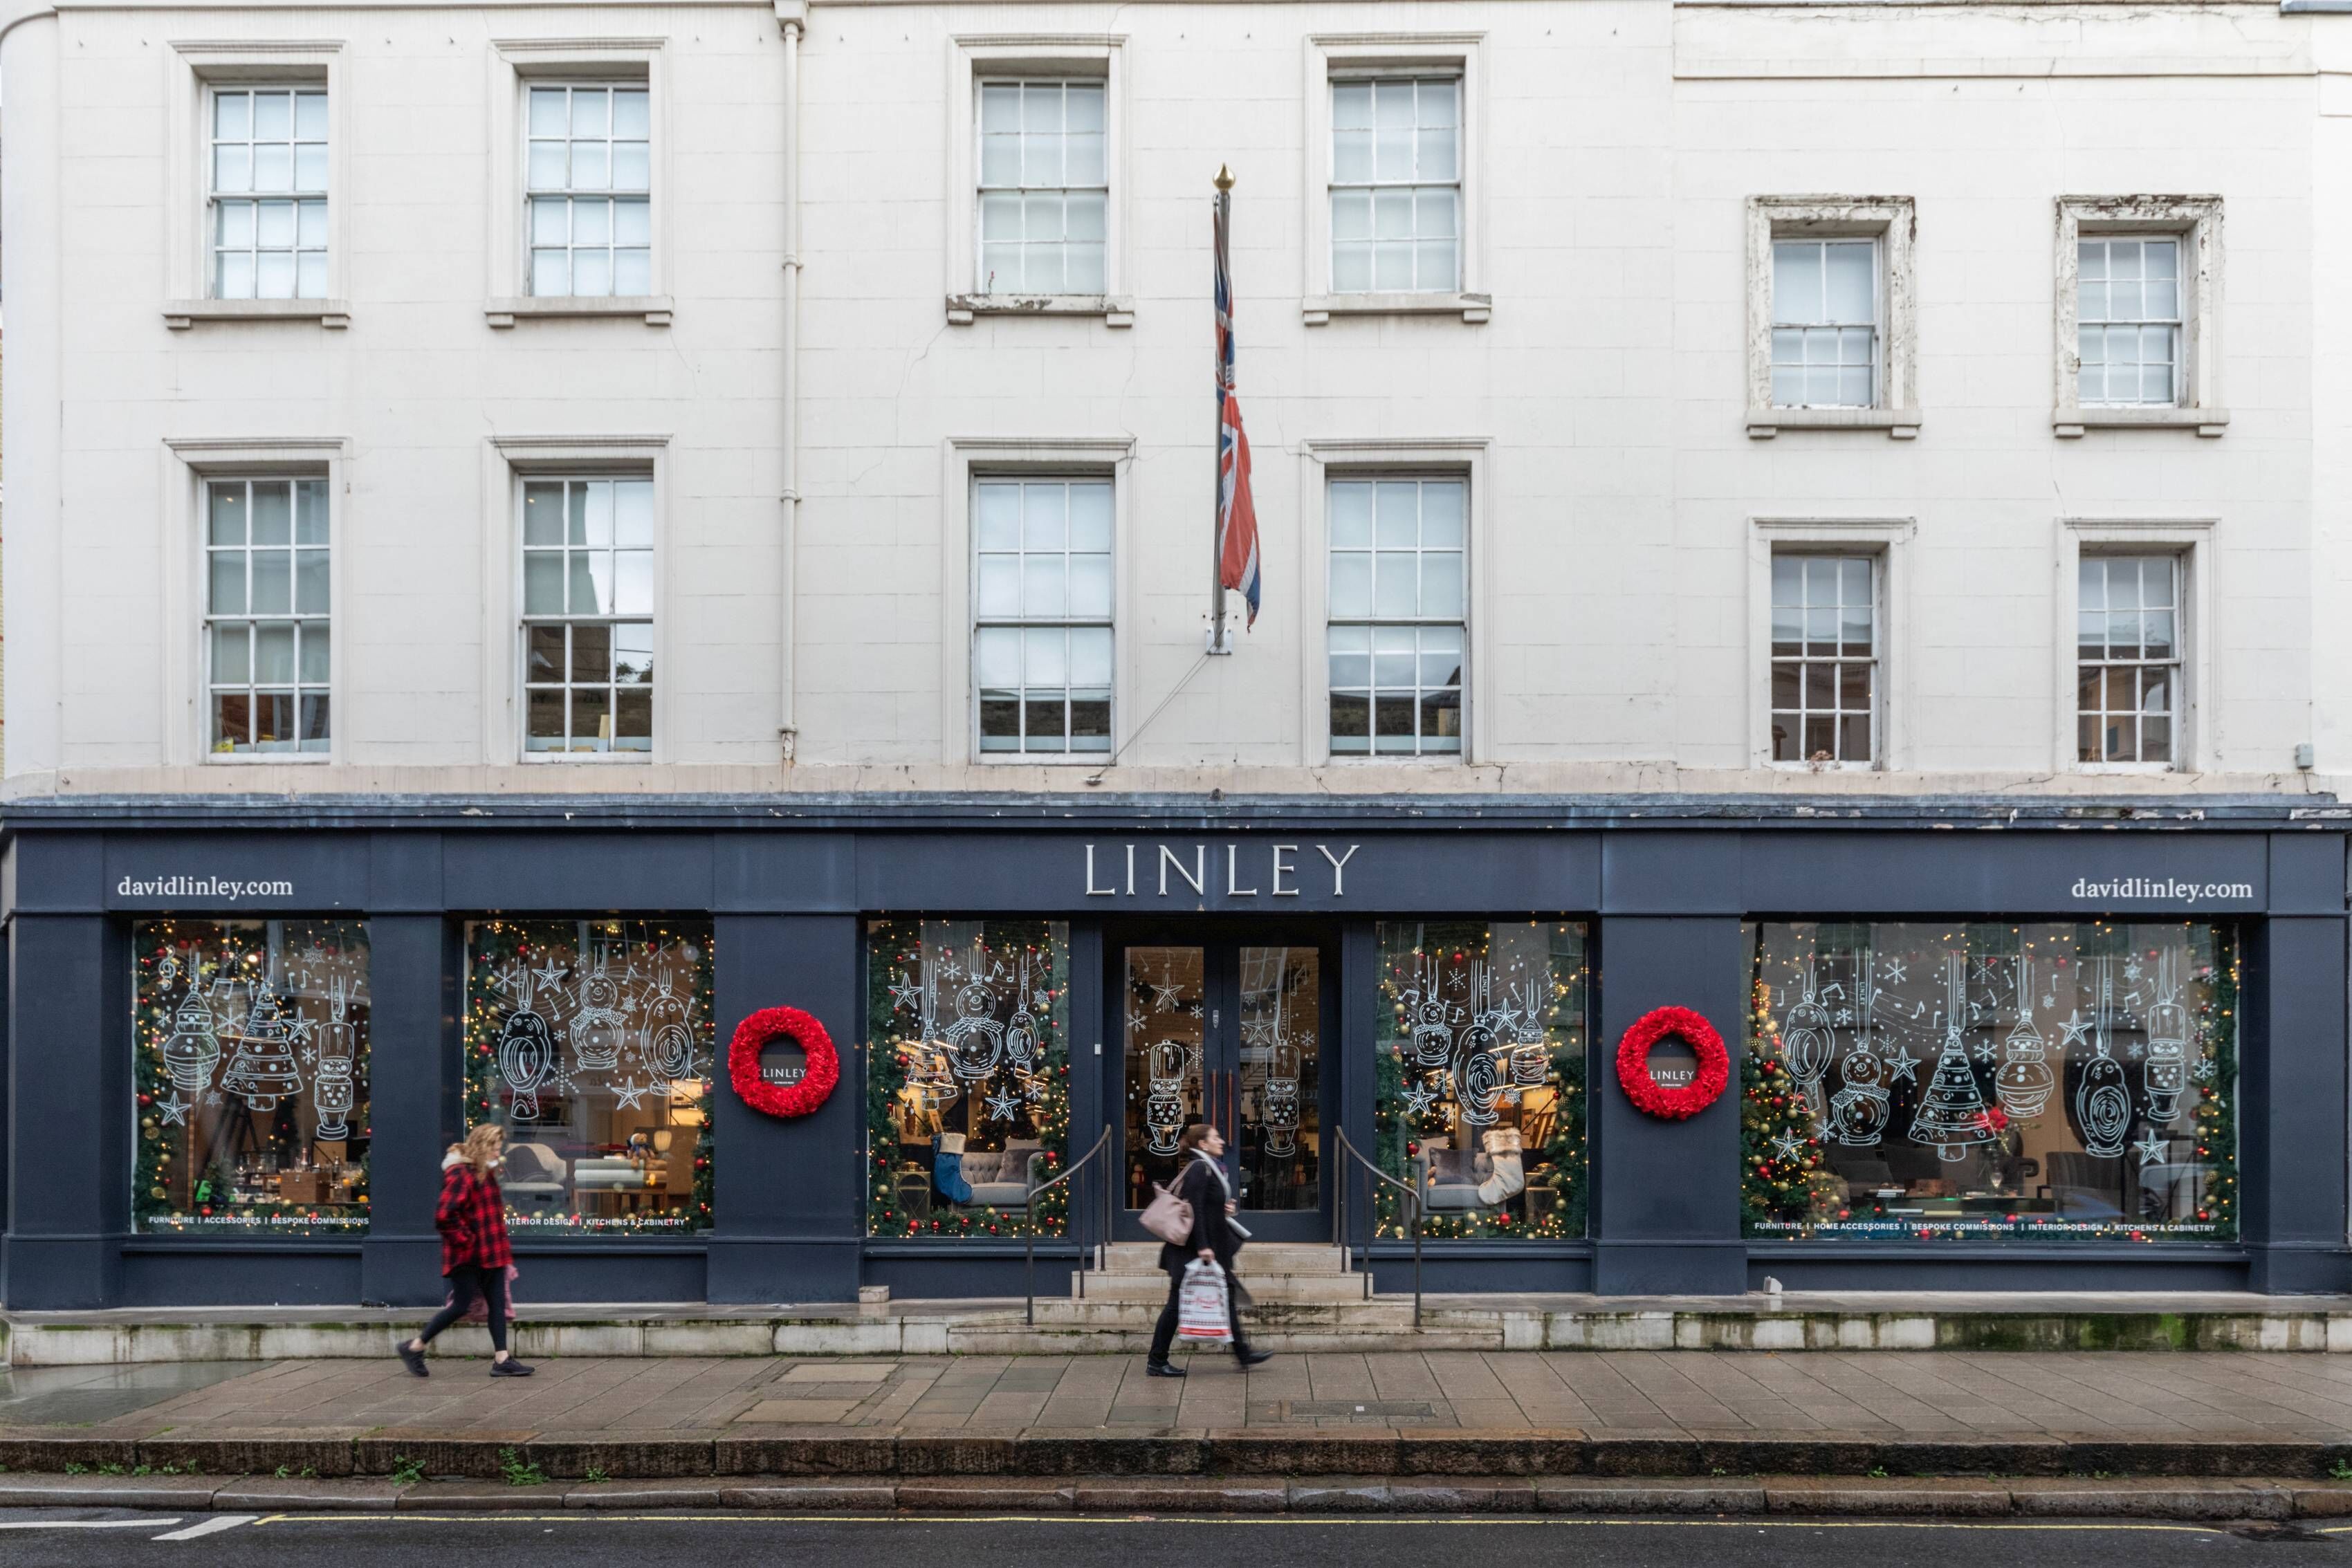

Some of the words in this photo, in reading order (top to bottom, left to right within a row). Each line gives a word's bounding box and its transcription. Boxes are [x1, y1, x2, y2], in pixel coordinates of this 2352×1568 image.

[1085, 845, 1360, 896] LINLEY
[117, 876, 293, 901] davidlinley.com
[2071, 878, 2253, 903] davidlinley.com
[763, 1068, 807, 1078] LINLEY
[1650, 1071, 1694, 1080] LINLEY
